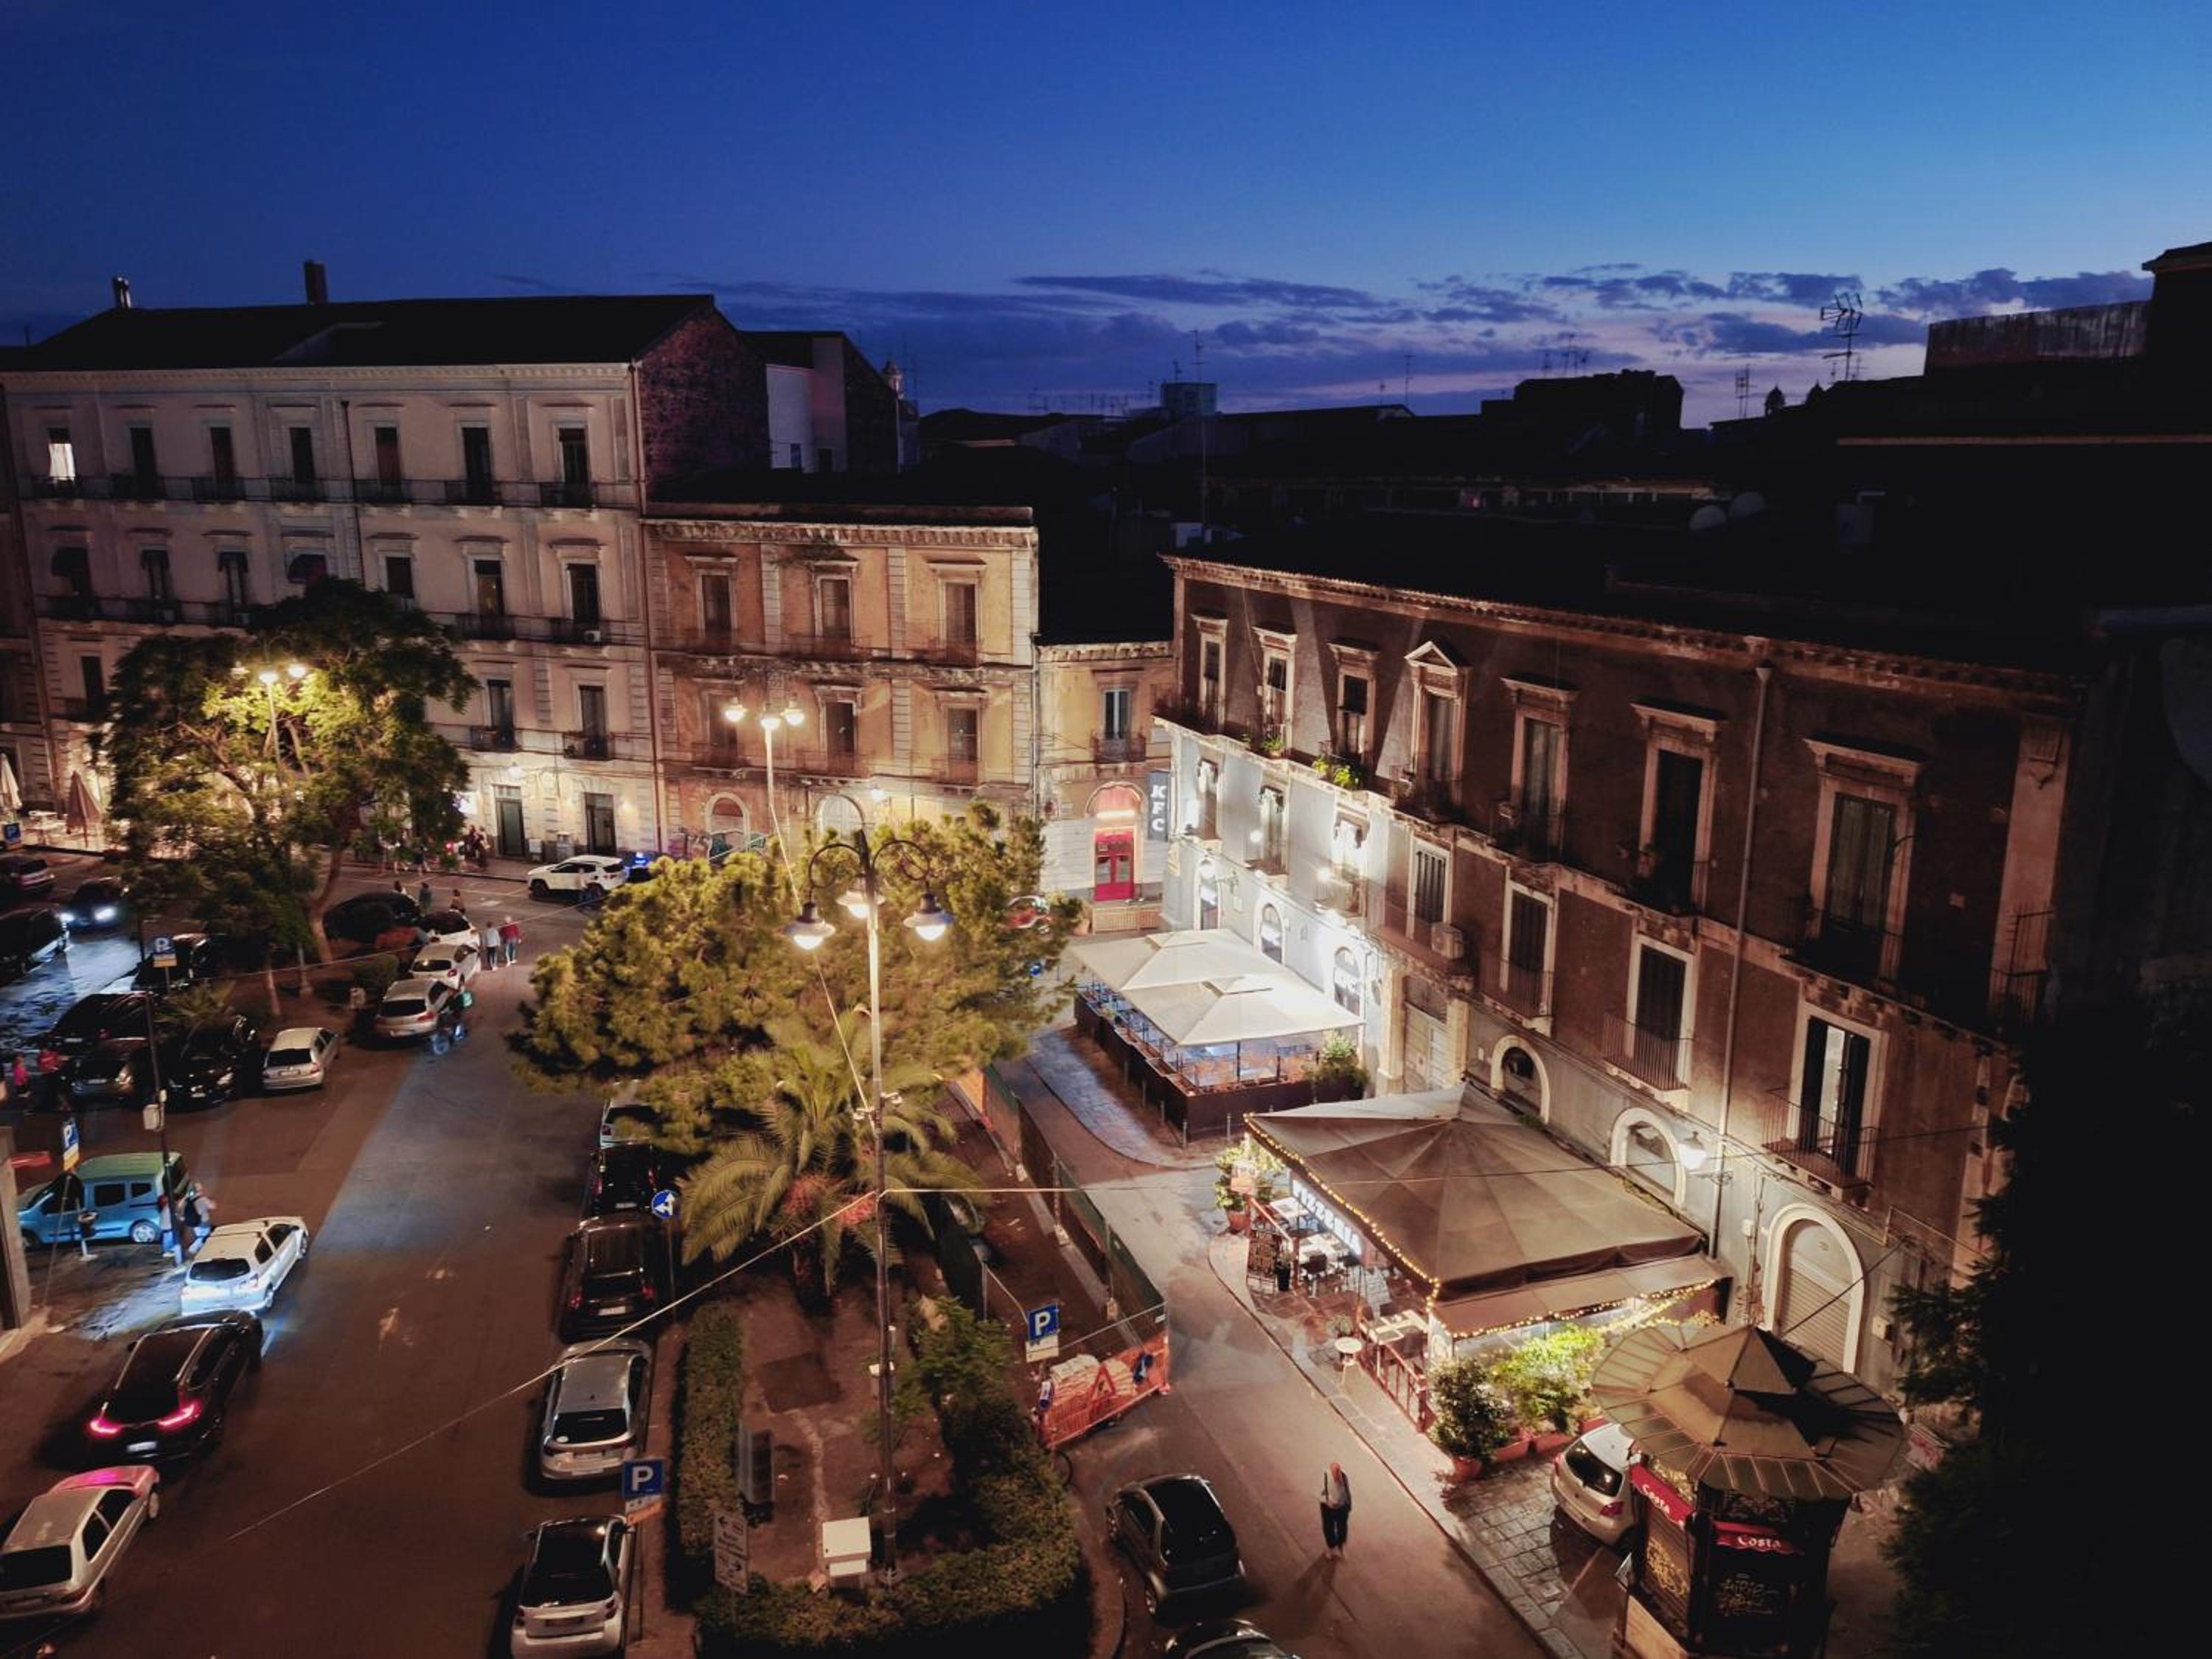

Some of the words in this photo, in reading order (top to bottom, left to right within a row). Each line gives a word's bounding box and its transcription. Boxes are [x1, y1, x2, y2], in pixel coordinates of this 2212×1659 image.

[1150, 785, 1167, 832] KFC
[7, 826, 17, 838] P
[155, 936, 170, 953] P
[63, 1124, 73, 1148] P
[1034, 1311, 1051, 1336] P
[631, 1466, 654, 1492] P
